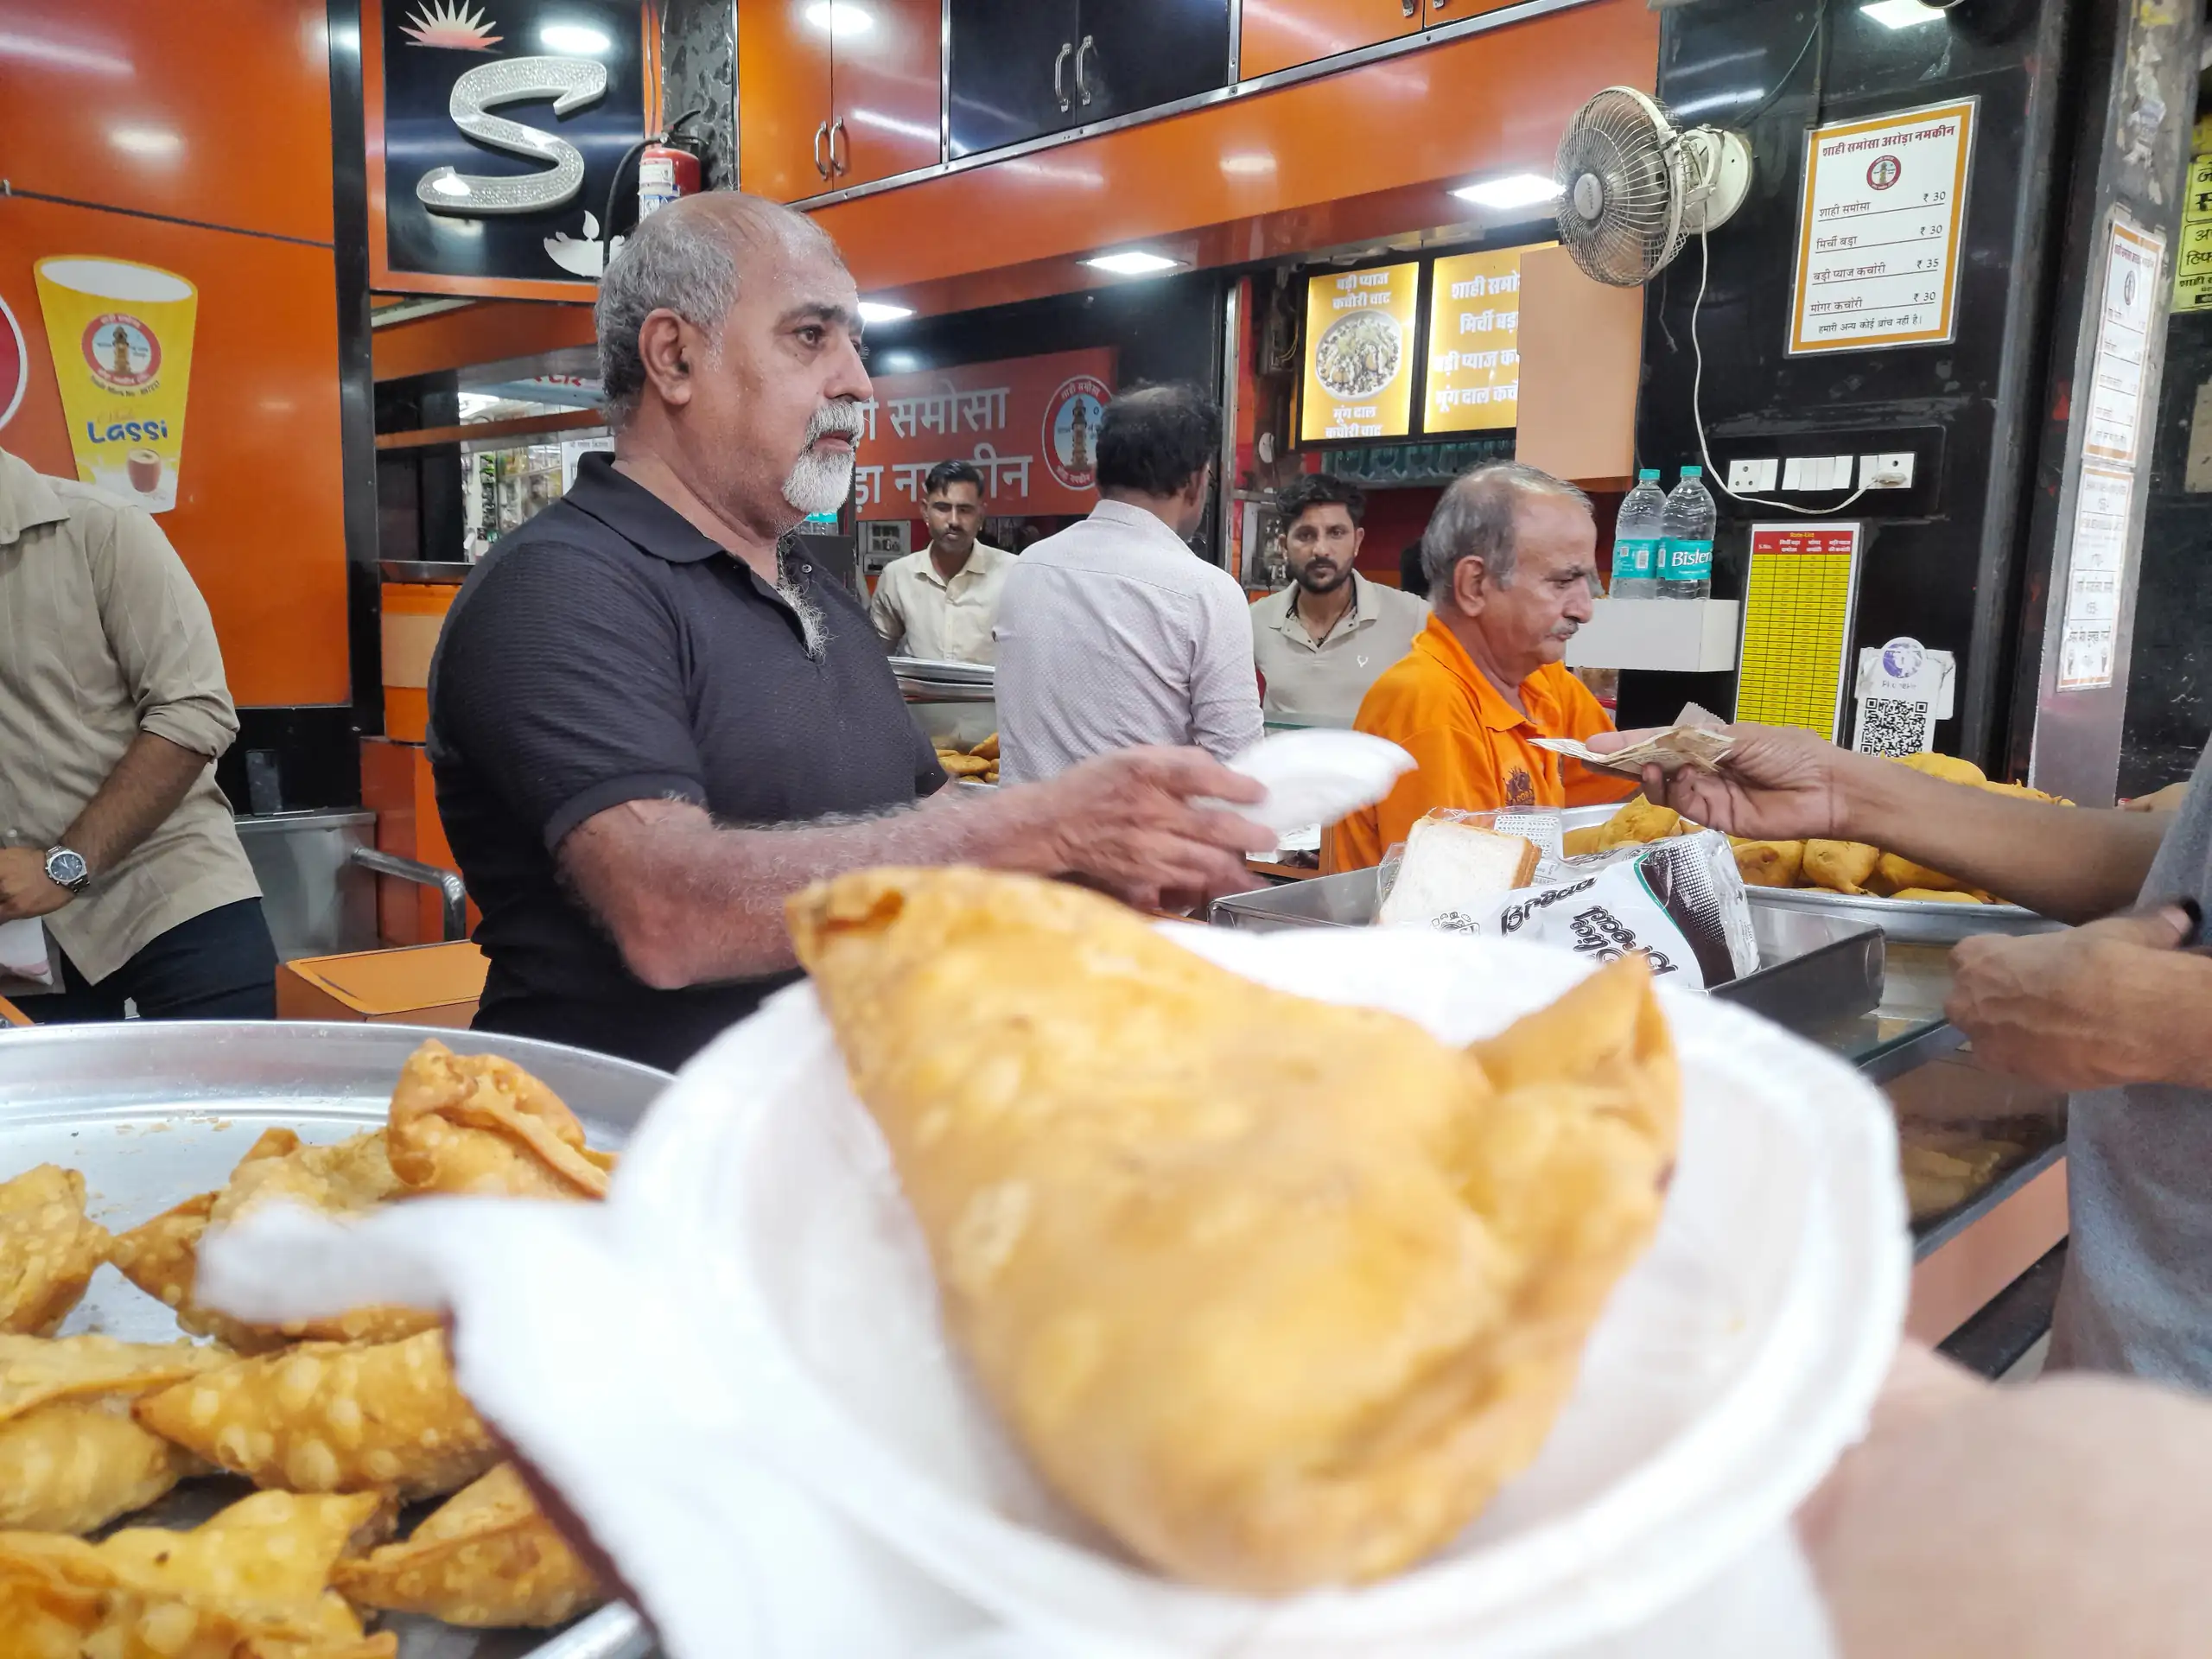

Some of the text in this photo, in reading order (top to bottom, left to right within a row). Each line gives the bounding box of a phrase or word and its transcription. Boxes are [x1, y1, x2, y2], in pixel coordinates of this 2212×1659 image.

[1822, 124, 1955, 157] शाही समोसा अरोड़ा नमकीन
[1819, 203, 1840, 218] शाही
[1842, 200, 1872, 213] समोसा
[1933, 191, 1946, 201] 30
[1816, 235, 1837, 250] मिर्ची
[1840, 235, 1858, 248] बड़ा
[1930, 225, 1942, 235] 30
[1833, 268, 1854, 278] प्याज
[1926, 258, 1939, 269] 35
[1452, 270, 1520, 300] शाही समो
[1923, 291, 1936, 302] 30
[1819, 322, 1837, 334] हमारी
[1840, 322, 1856, 331] अन्य
[1859, 317, 1875, 330] कोई
[887, 380, 1010, 439] समोसा
[86, 419, 168, 444] Lassi
